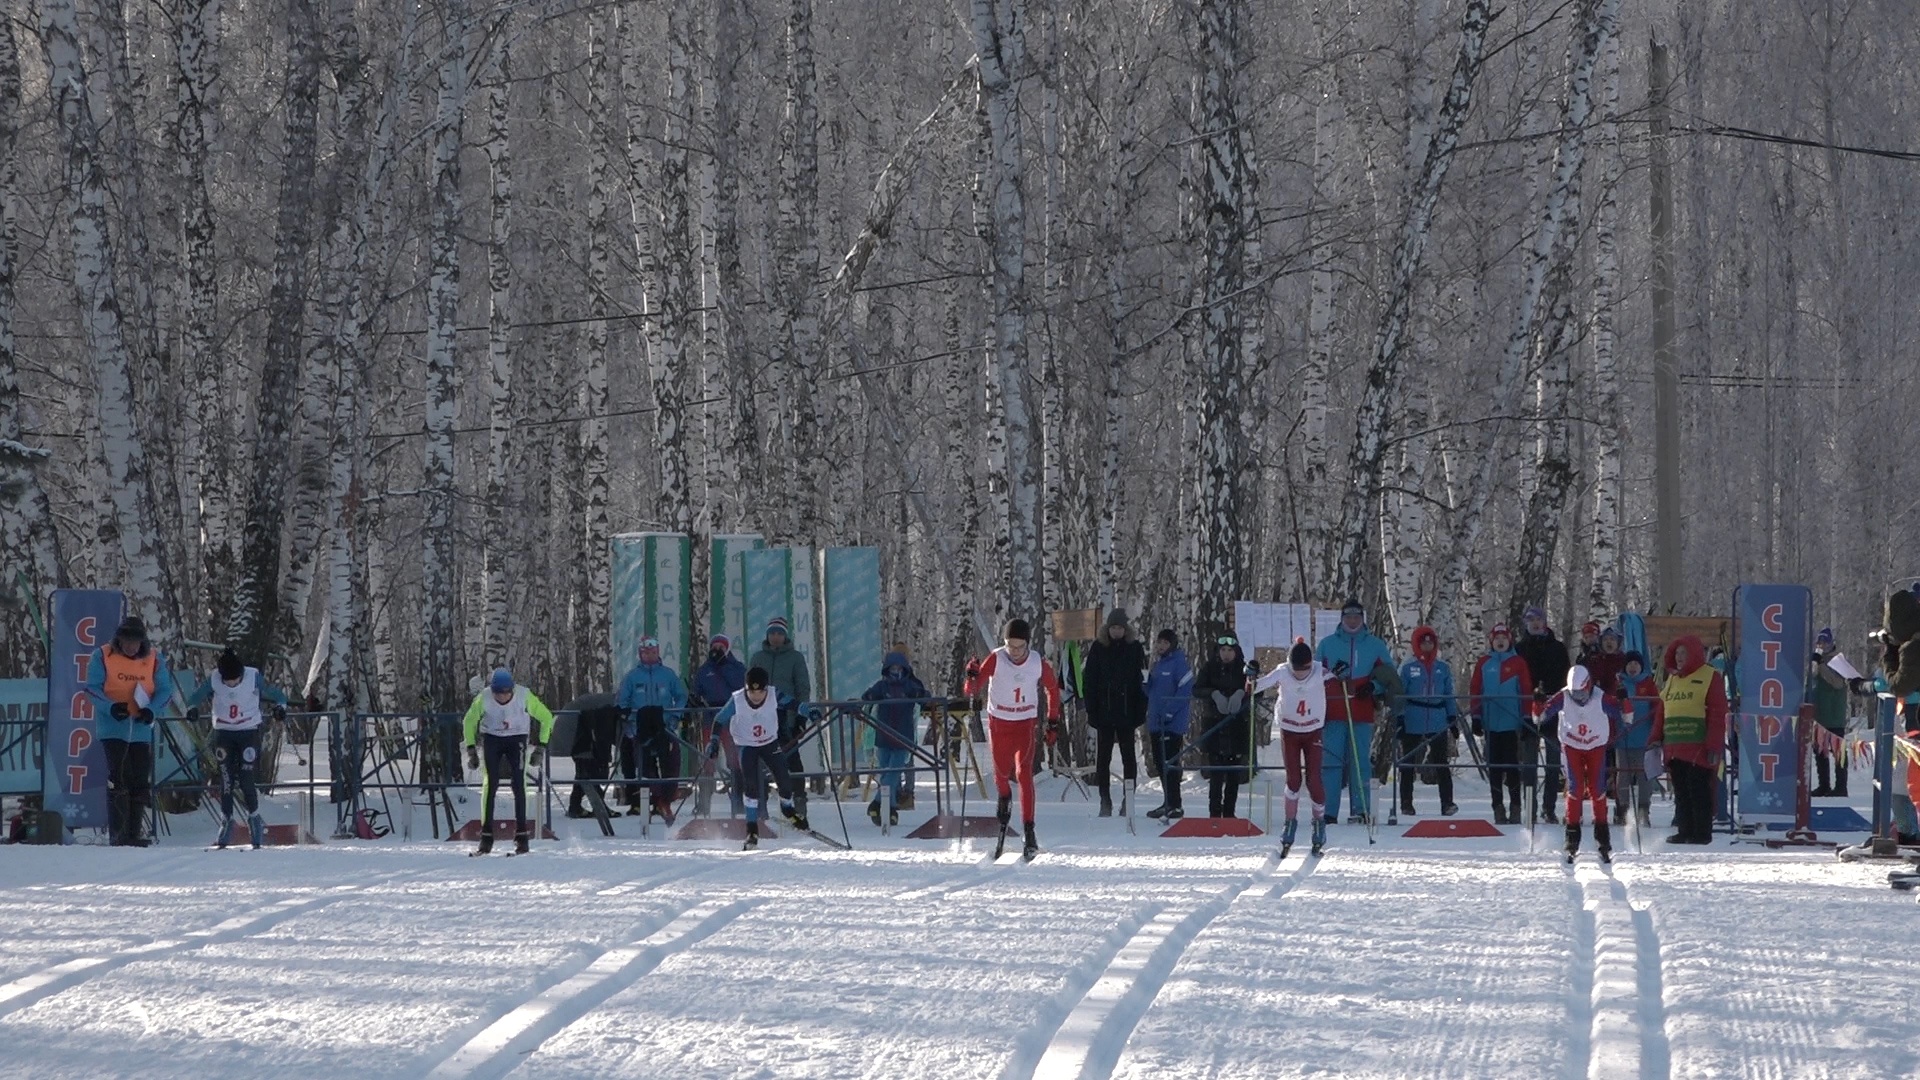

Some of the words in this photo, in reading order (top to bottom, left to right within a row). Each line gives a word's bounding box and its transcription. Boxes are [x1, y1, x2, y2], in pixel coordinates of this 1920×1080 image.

[1013, 687, 1021, 703] 1
[1665, 691, 1695, 701] УДЬЯ
[1759, 603, 1784, 783] СТАРТ
[67, 616, 97, 795] СТАРТ
[1296, 700, 1306, 716] 4
[753, 725, 762, 738] 3
